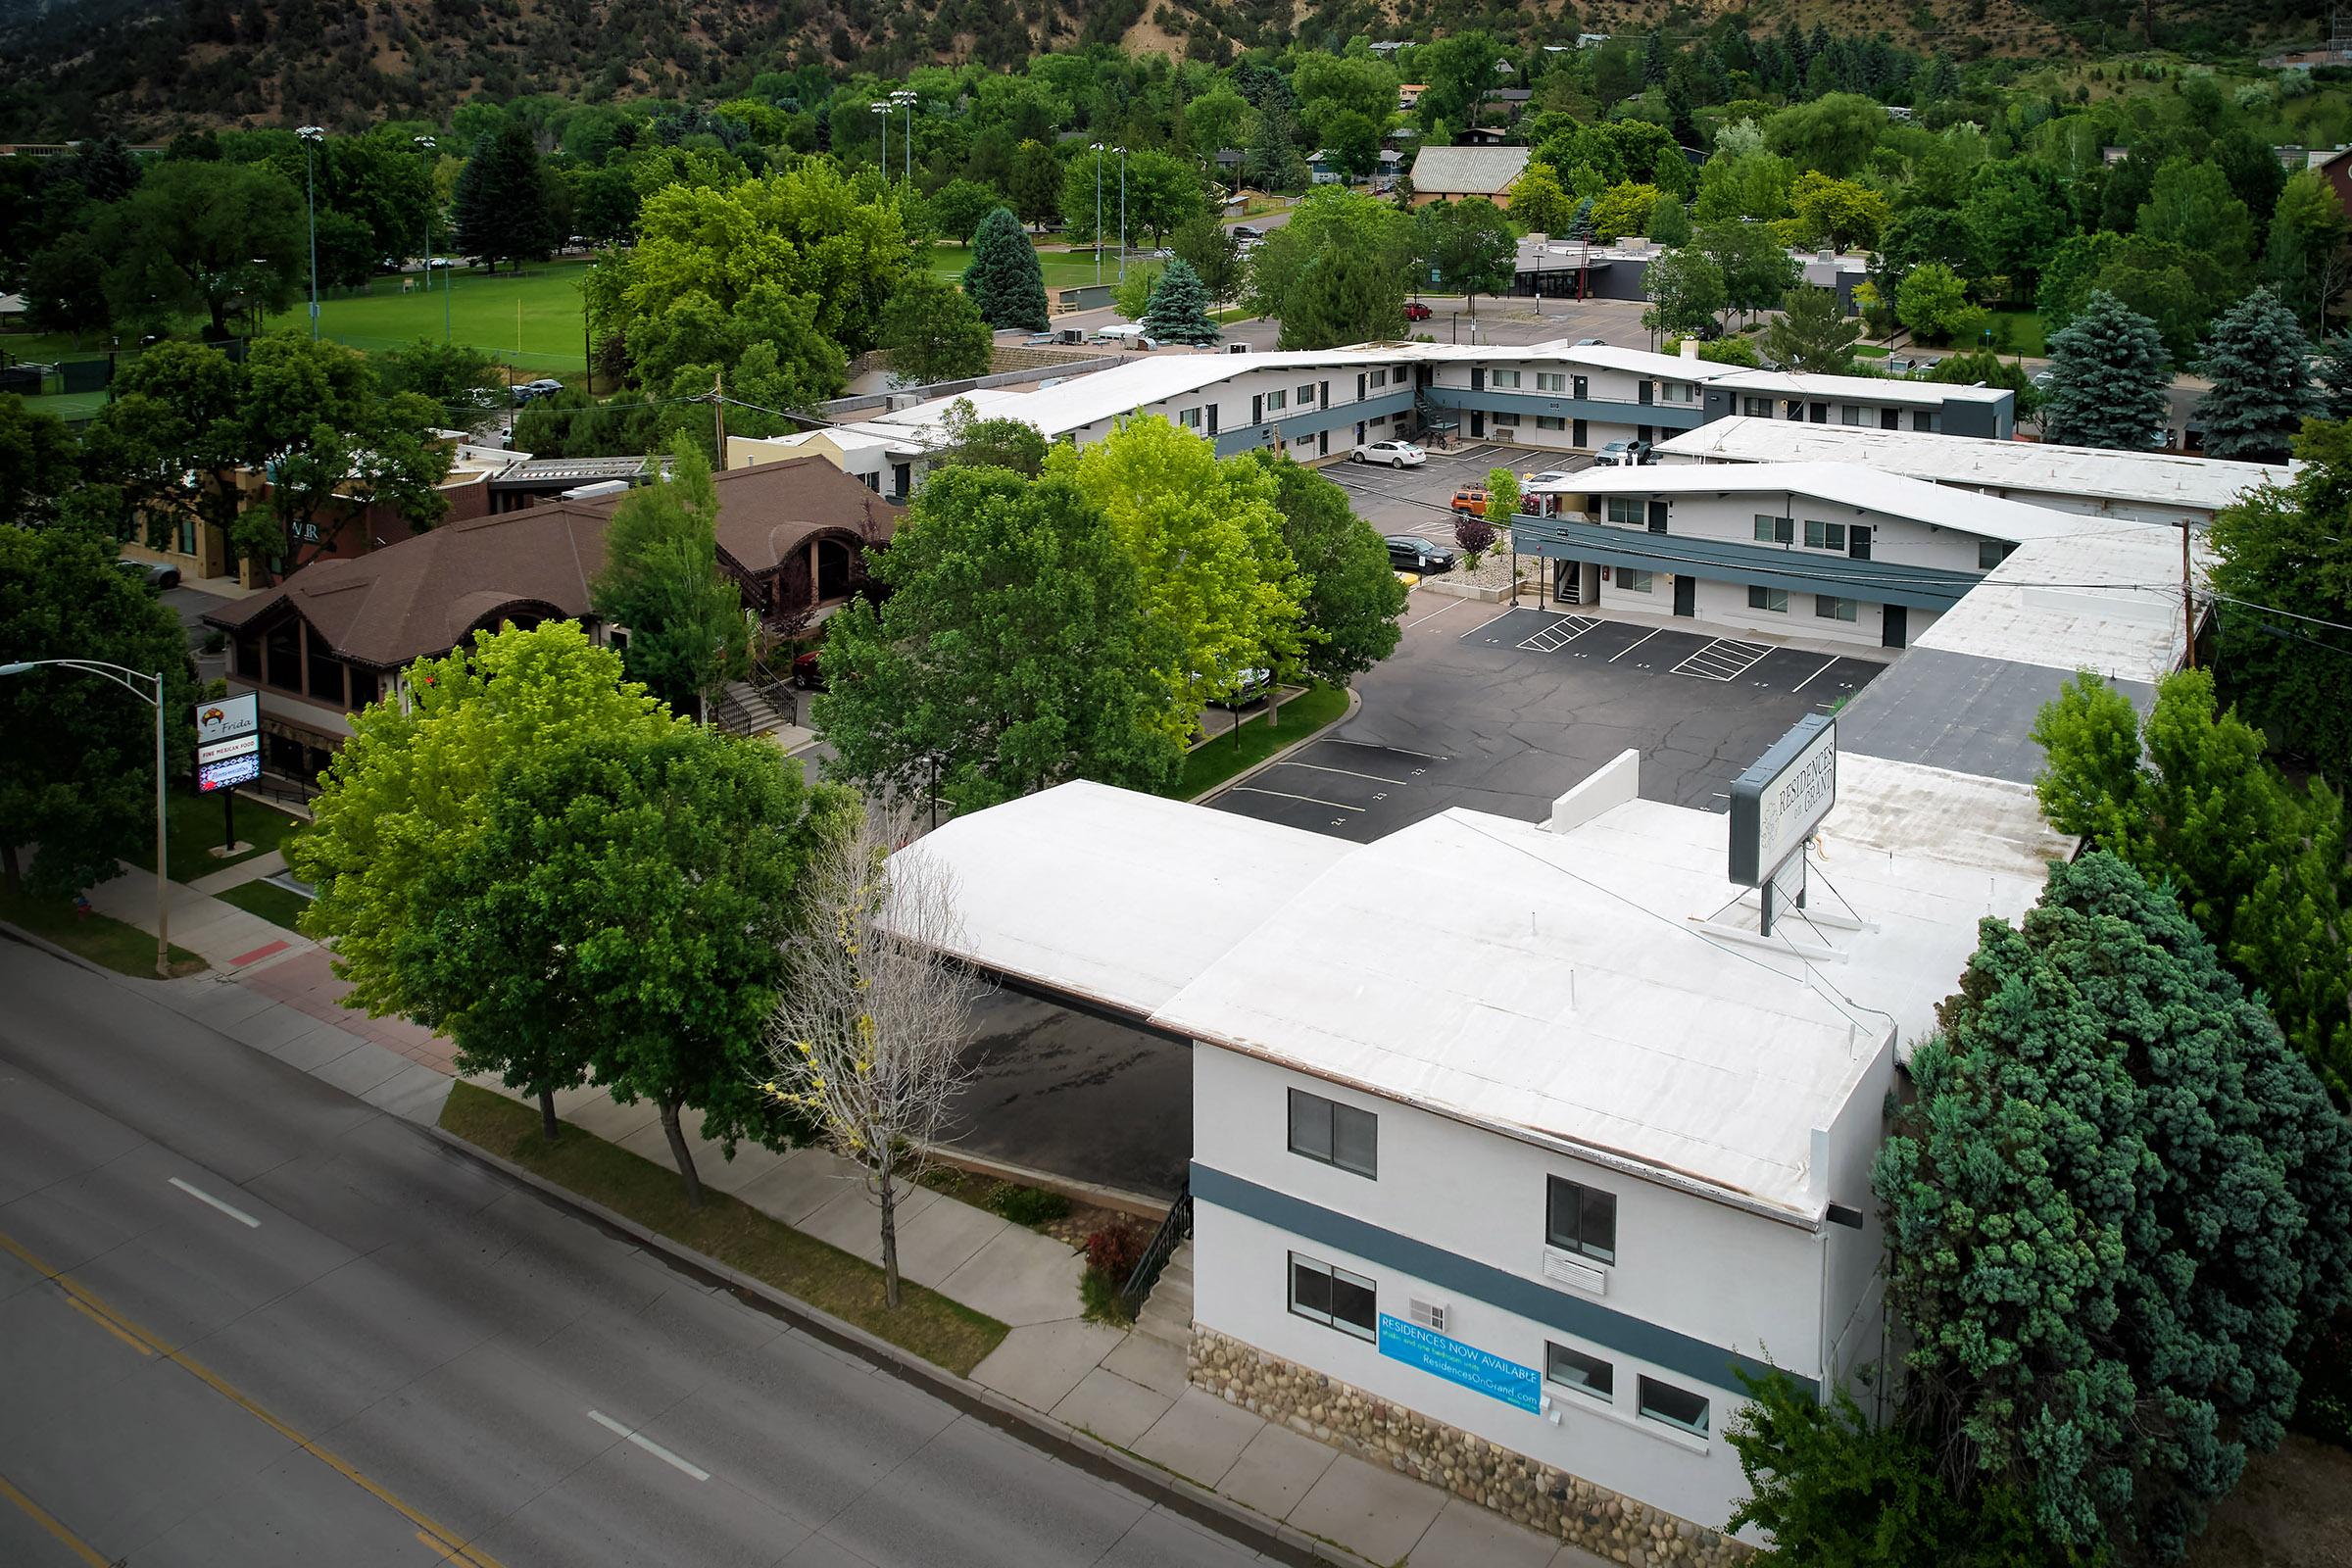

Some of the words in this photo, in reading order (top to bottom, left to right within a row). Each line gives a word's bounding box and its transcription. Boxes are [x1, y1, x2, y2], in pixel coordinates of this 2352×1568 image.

[221, 719, 251, 733] Frida
[1410, 767, 1426, 777] 22
[1779, 741, 1834, 815] RESIDENCES
[1794, 804, 1803, 819] on
[1805, 767, 1834, 811] GRAND
[1330, 816, 1347, 827] 24
[1382, 1316, 1446, 1349] RESIDENCES
[1448, 1343, 1479, 1361] NOW
[1481, 1355, 1538, 1384] AVAILABLE
[1423, 1352, 1538, 1405] ResidencesOnGrand.com
